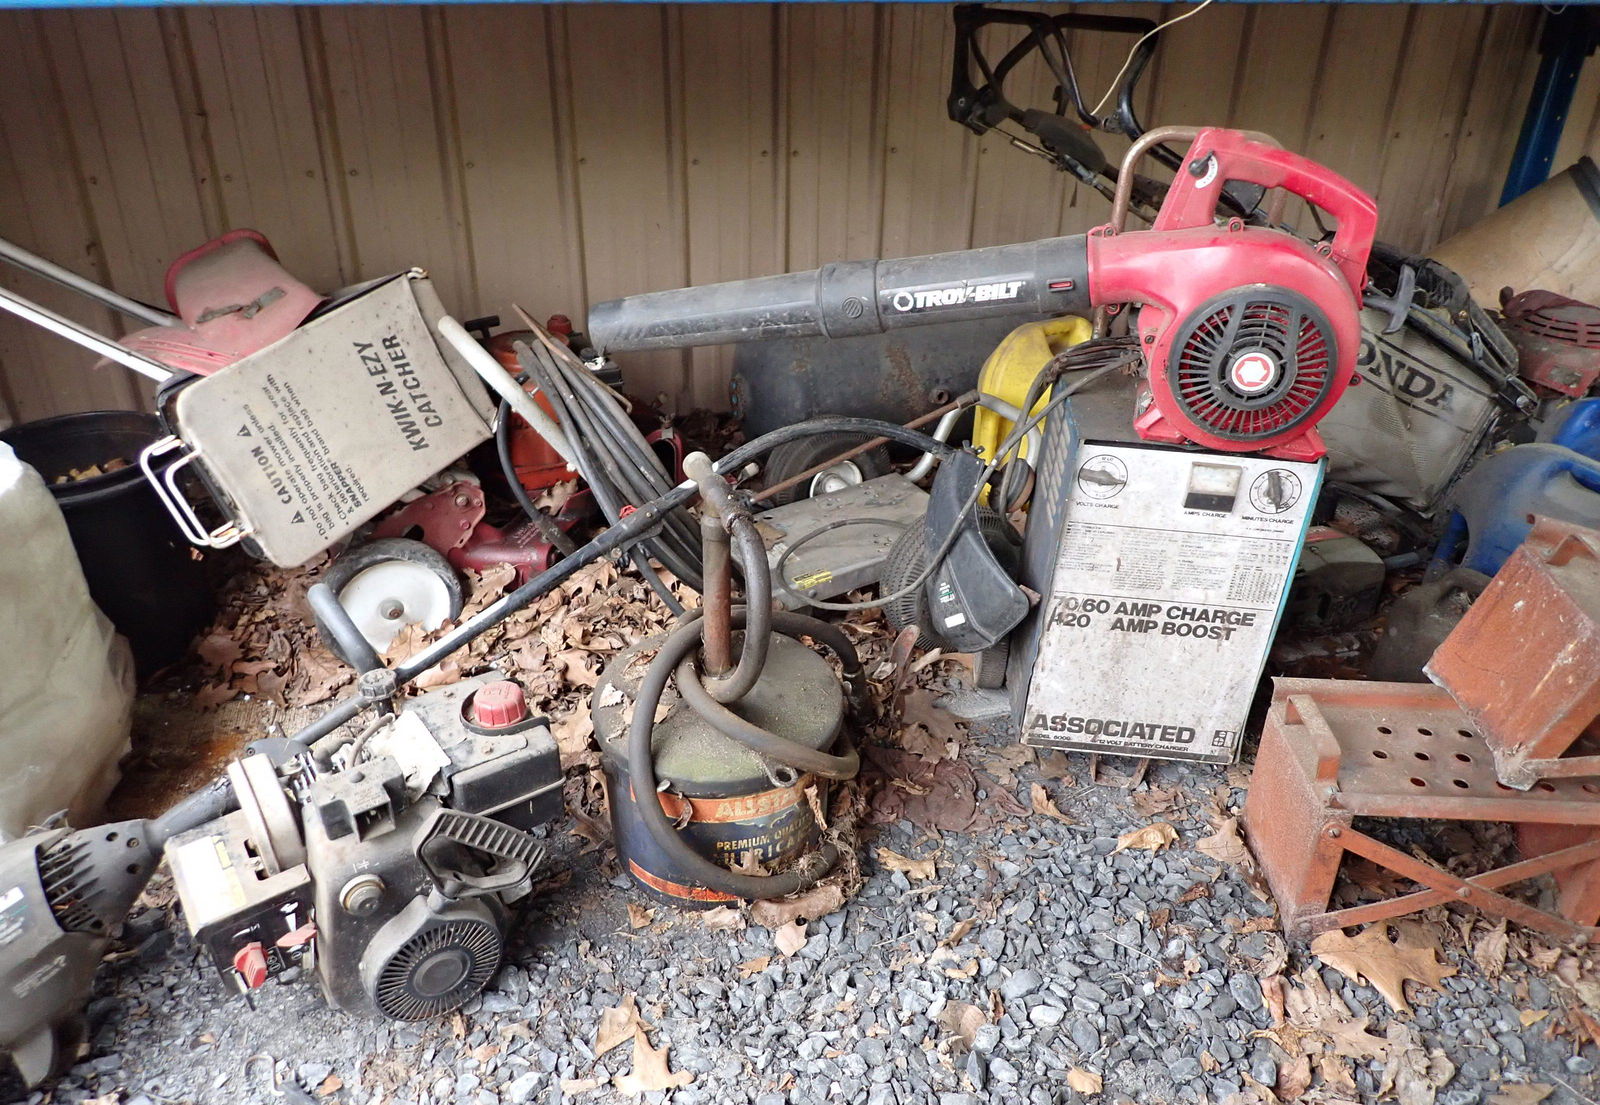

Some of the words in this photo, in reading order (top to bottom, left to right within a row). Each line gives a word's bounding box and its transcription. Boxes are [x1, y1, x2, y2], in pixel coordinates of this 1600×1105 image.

[914, 281, 1022, 308] TROY-BILT
[266, 373, 281, 394] with
[382, 335, 443, 427] CATCHER
[1358, 338, 1454, 412] ONDA
[260, 385, 279, 409] wear
[282, 381, 301, 407] when
[353, 342, 430, 451] KWIK-N-EZY
[241, 403, 265, 434] unless
[276, 410, 289, 425] for
[279, 395, 305, 430] replace
[299, 407, 314, 428] bag
[262, 435, 286, 467] mower
[287, 426, 318, 472] frequently
[300, 430, 316, 448] and
[309, 427, 330, 456] brand
[250, 445, 293, 504] CAUTION
[284, 468, 308, 504] operate
[292, 463, 319, 502] properly
[311, 448, 349, 505] deterioration
[315, 471, 330, 492] bag
[304, 504, 318, 521] not
[315, 501, 324, 512] is
[326, 490, 347, 520] Check
[315, 521, 327, 536] Do
[320, 510, 335, 530] bag
[1242, 515, 1267, 523] MINUTES
[1113, 601, 1162, 618] AMP
[1166, 605, 1256, 627] CHARGE
[1110, 617, 1159, 634] AMP
[1161, 622, 1236, 641] BOOST
[1029, 713, 1196, 744] ASSOCIATED
[1124, 741, 1154, 749] BATTERY
[1155, 744, 1189, 752] CHARGER
[716, 835, 770, 851] PREMIUM
